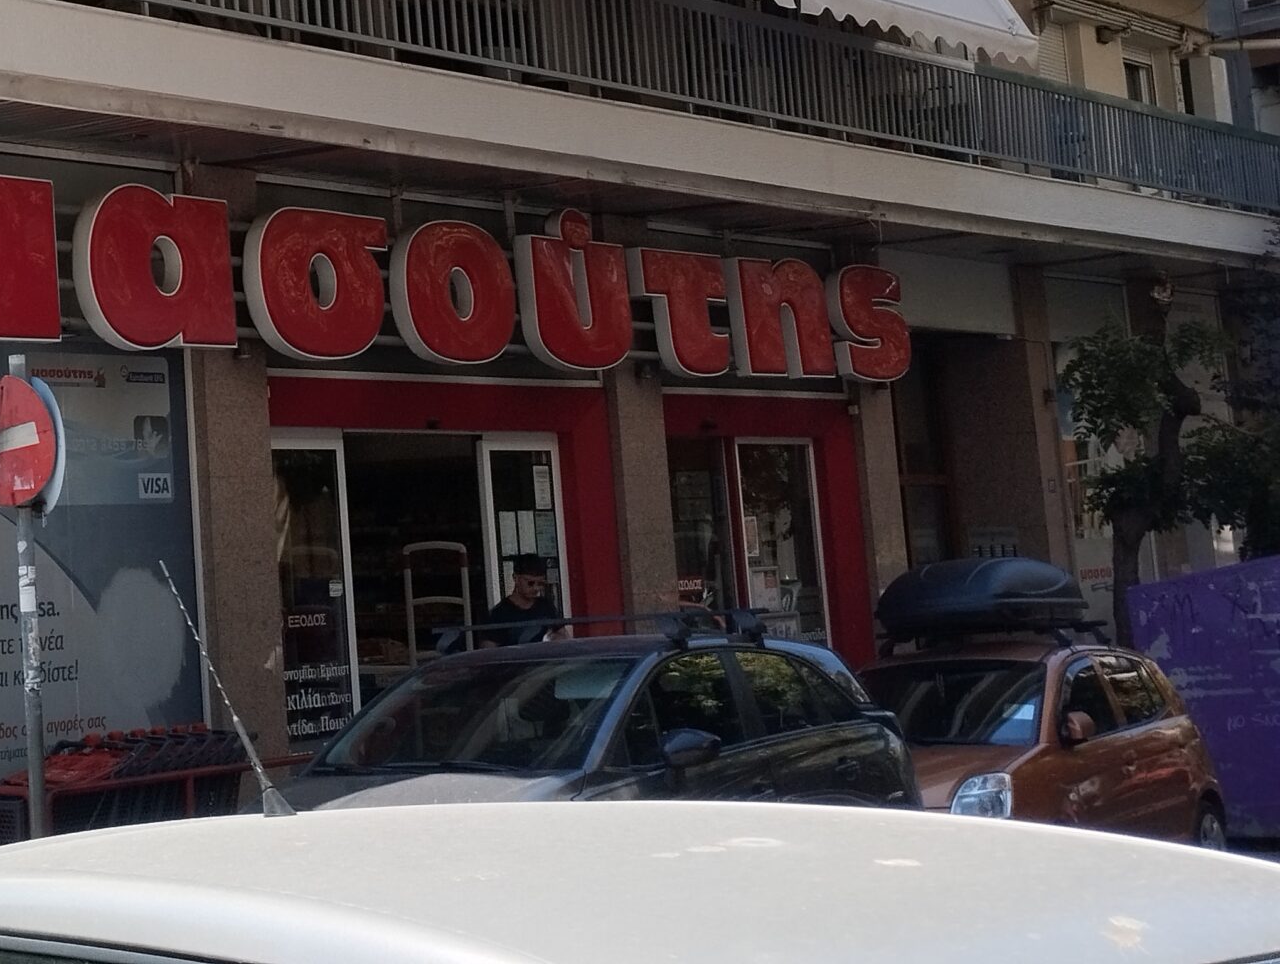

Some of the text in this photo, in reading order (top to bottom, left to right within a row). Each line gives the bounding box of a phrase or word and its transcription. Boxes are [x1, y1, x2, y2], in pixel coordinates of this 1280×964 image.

[143, 477, 170, 494] VISA
[38, 600, 60, 617] sa.
[288, 613, 327, 628] ΕΞΟΔΟΣ
[39, 629, 64, 652] νέα
[46, 714, 84, 737] αγορές
[87, 715, 107, 731] σας
